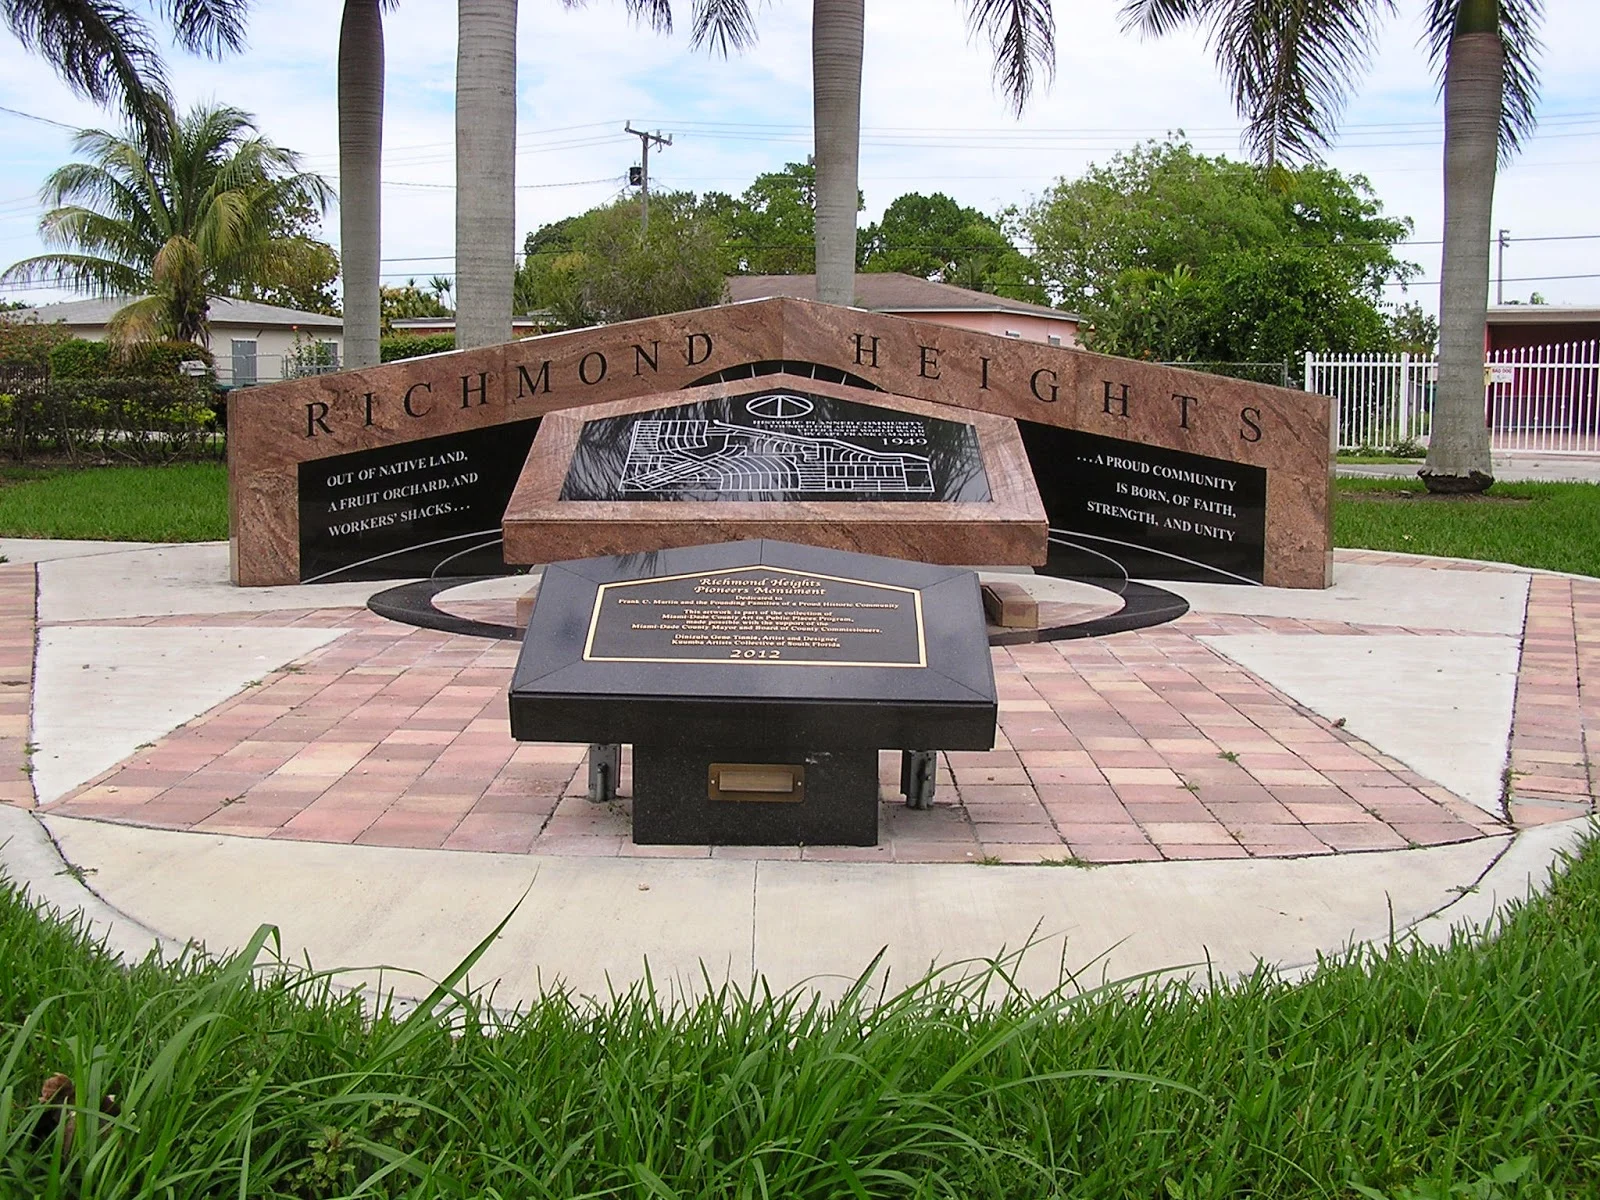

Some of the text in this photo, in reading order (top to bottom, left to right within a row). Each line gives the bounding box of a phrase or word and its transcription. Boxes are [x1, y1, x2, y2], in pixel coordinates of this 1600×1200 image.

[305, 332, 1262, 442] RICHMOND HEIGHTS
[883, 438, 928, 446] 1949
[327, 450, 468, 487] OUT OF NATIVE LAND,
[1106, 455, 1150, 474] PROUD
[1152, 465, 1237, 492] COMMUNITY
[327, 472, 479, 513] A FRUIT ORCHARD, AND
[1116, 482, 1237, 519] IS BORN, OF FAITH,
[1087, 500, 1235, 542] STRENGTH, AND UNITY
[699, 578, 821, 589] Richmond Heights
[754, 587, 826, 595] Monument
[730, 649, 780, 659] 2012
